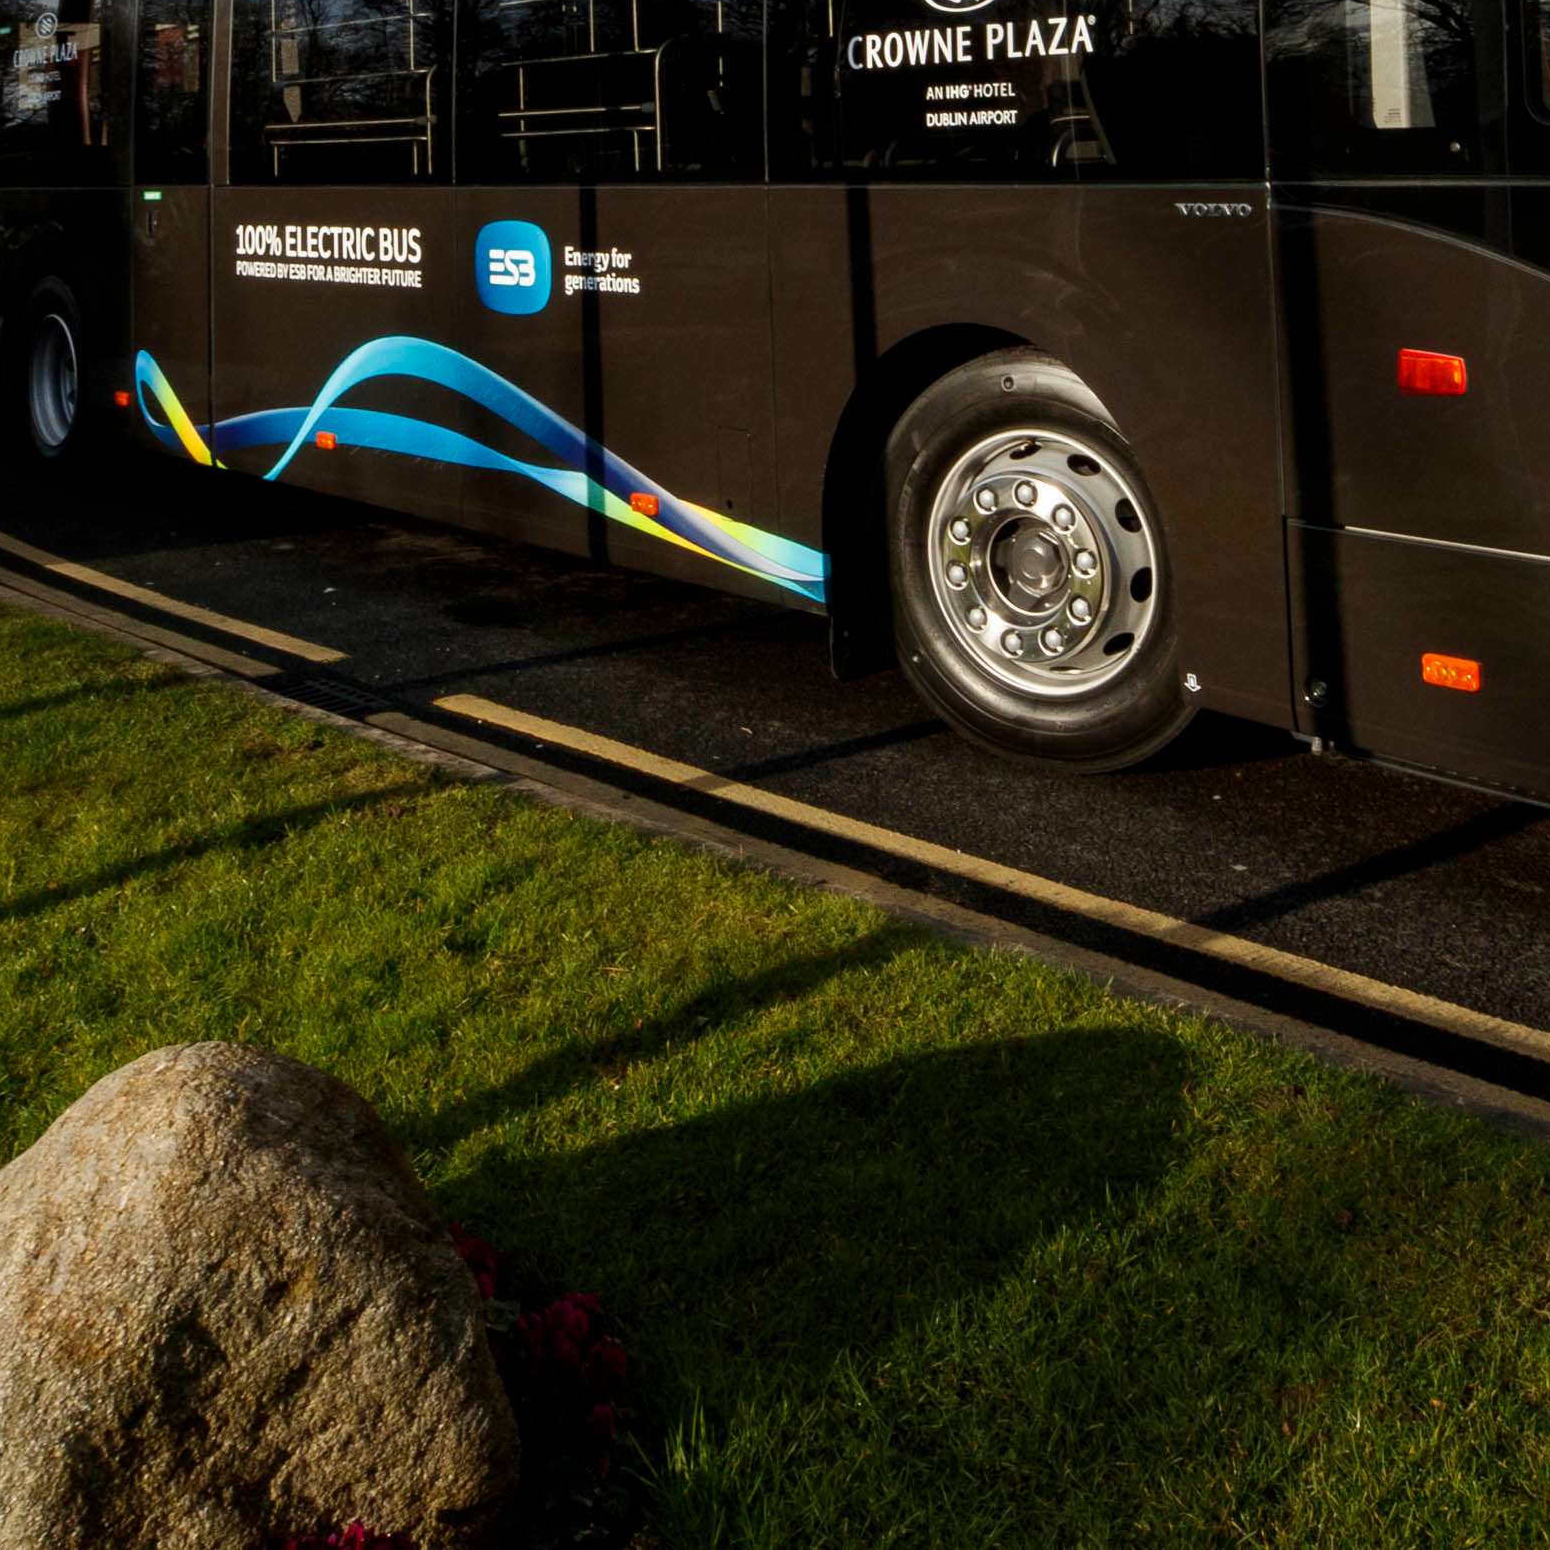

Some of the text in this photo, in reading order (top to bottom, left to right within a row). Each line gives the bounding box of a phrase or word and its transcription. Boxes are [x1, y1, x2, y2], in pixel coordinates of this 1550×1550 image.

[848, 16, 1094, 70] CROWNE PLAZA
[926, 86, 943, 100] AN
[974, 83, 1016, 98] HOTEL
[926, 110, 1018, 127] DUBLIN AIRPORT
[1174, 203, 1252, 217] VOLVO
[236, 225, 421, 264] 100% ELECTRIC BUS
[489, 249, 536, 286] ESB
[564, 246, 633, 273] Energy for
[236, 260, 422, 288] POWERED BY ESB FOR A BRIGHTER FUTURE
[564, 273, 640, 296] generations
